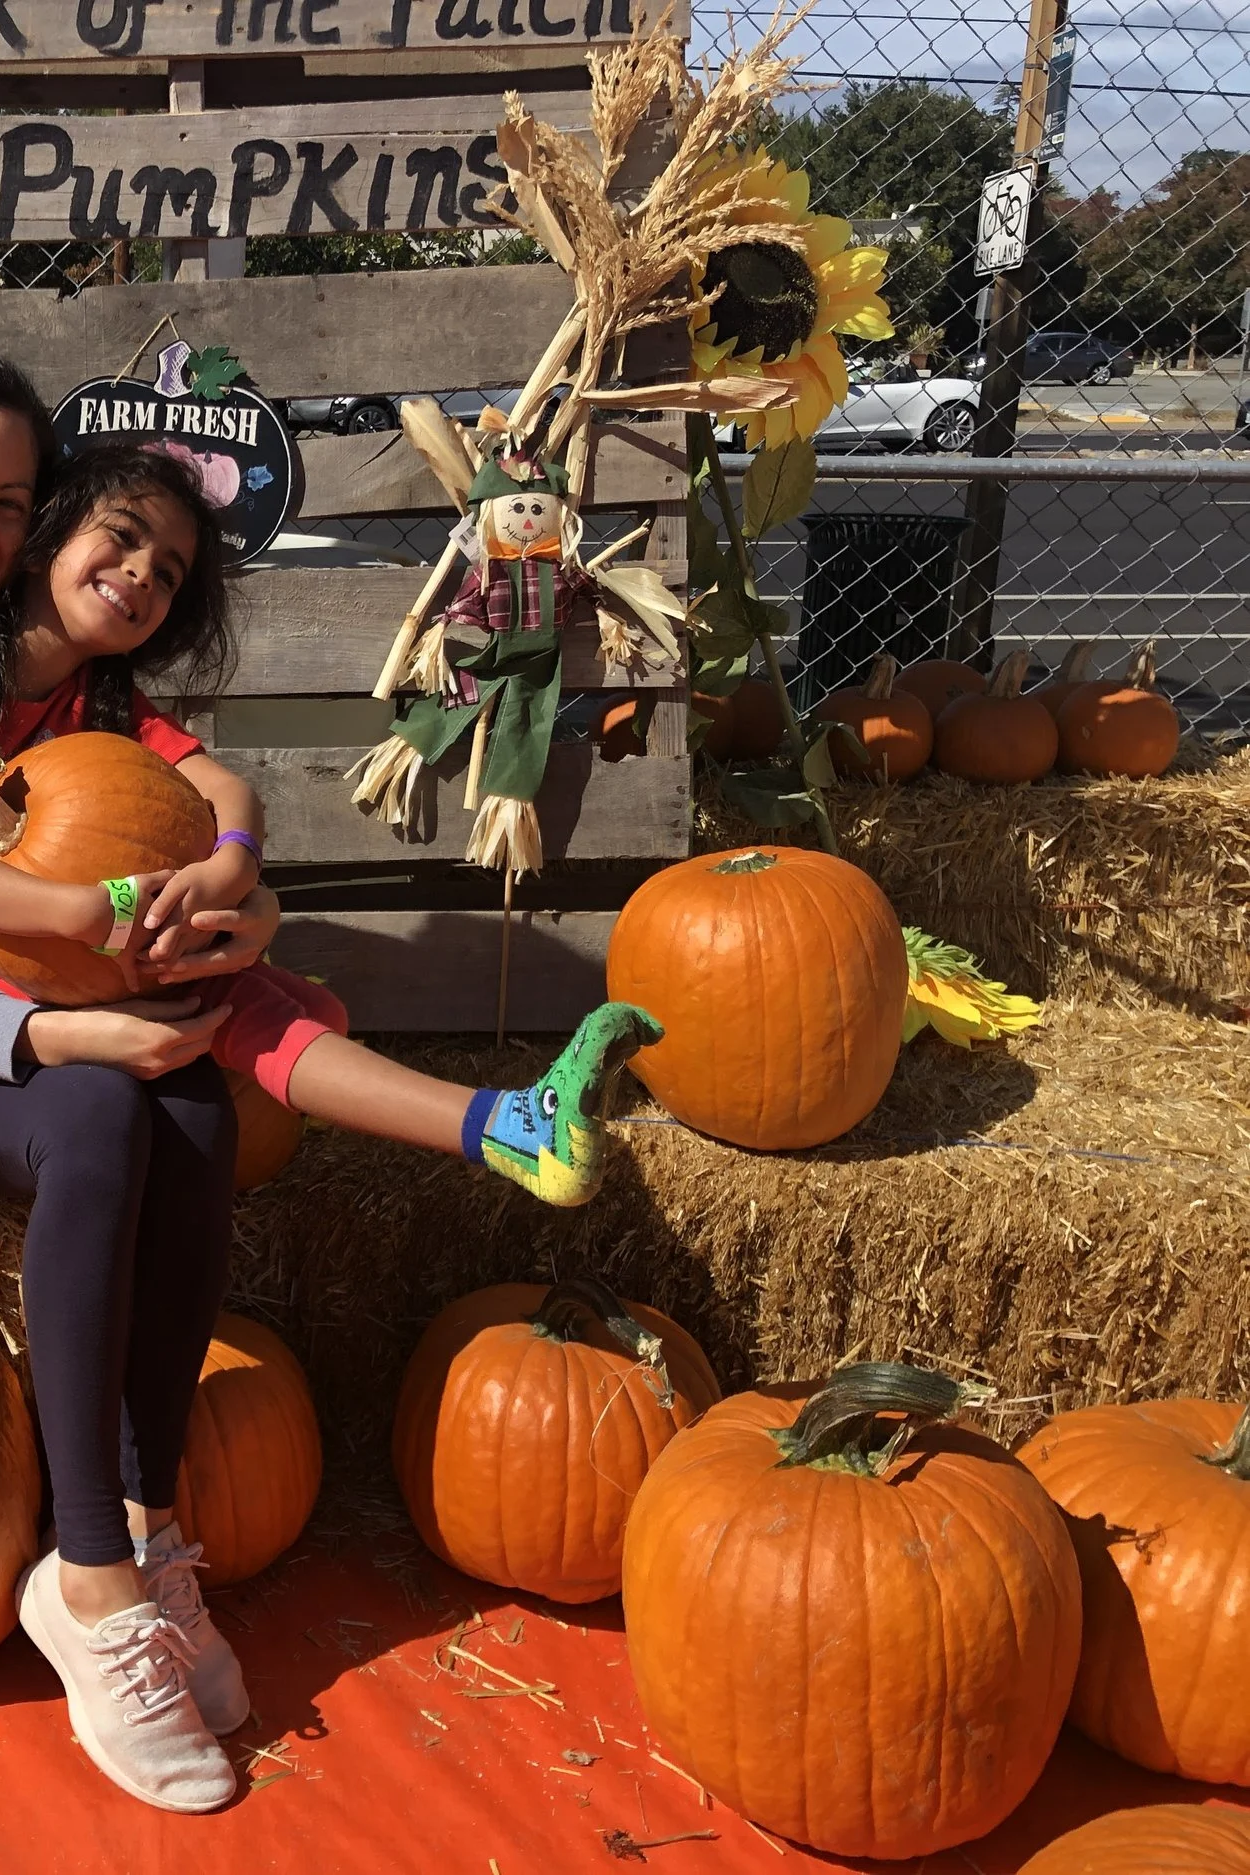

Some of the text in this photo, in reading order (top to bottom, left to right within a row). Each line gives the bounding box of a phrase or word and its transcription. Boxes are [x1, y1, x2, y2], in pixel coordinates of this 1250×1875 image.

[997, 242, 1019, 263] LANE
[77, 398, 260, 447] FARM FRESH
